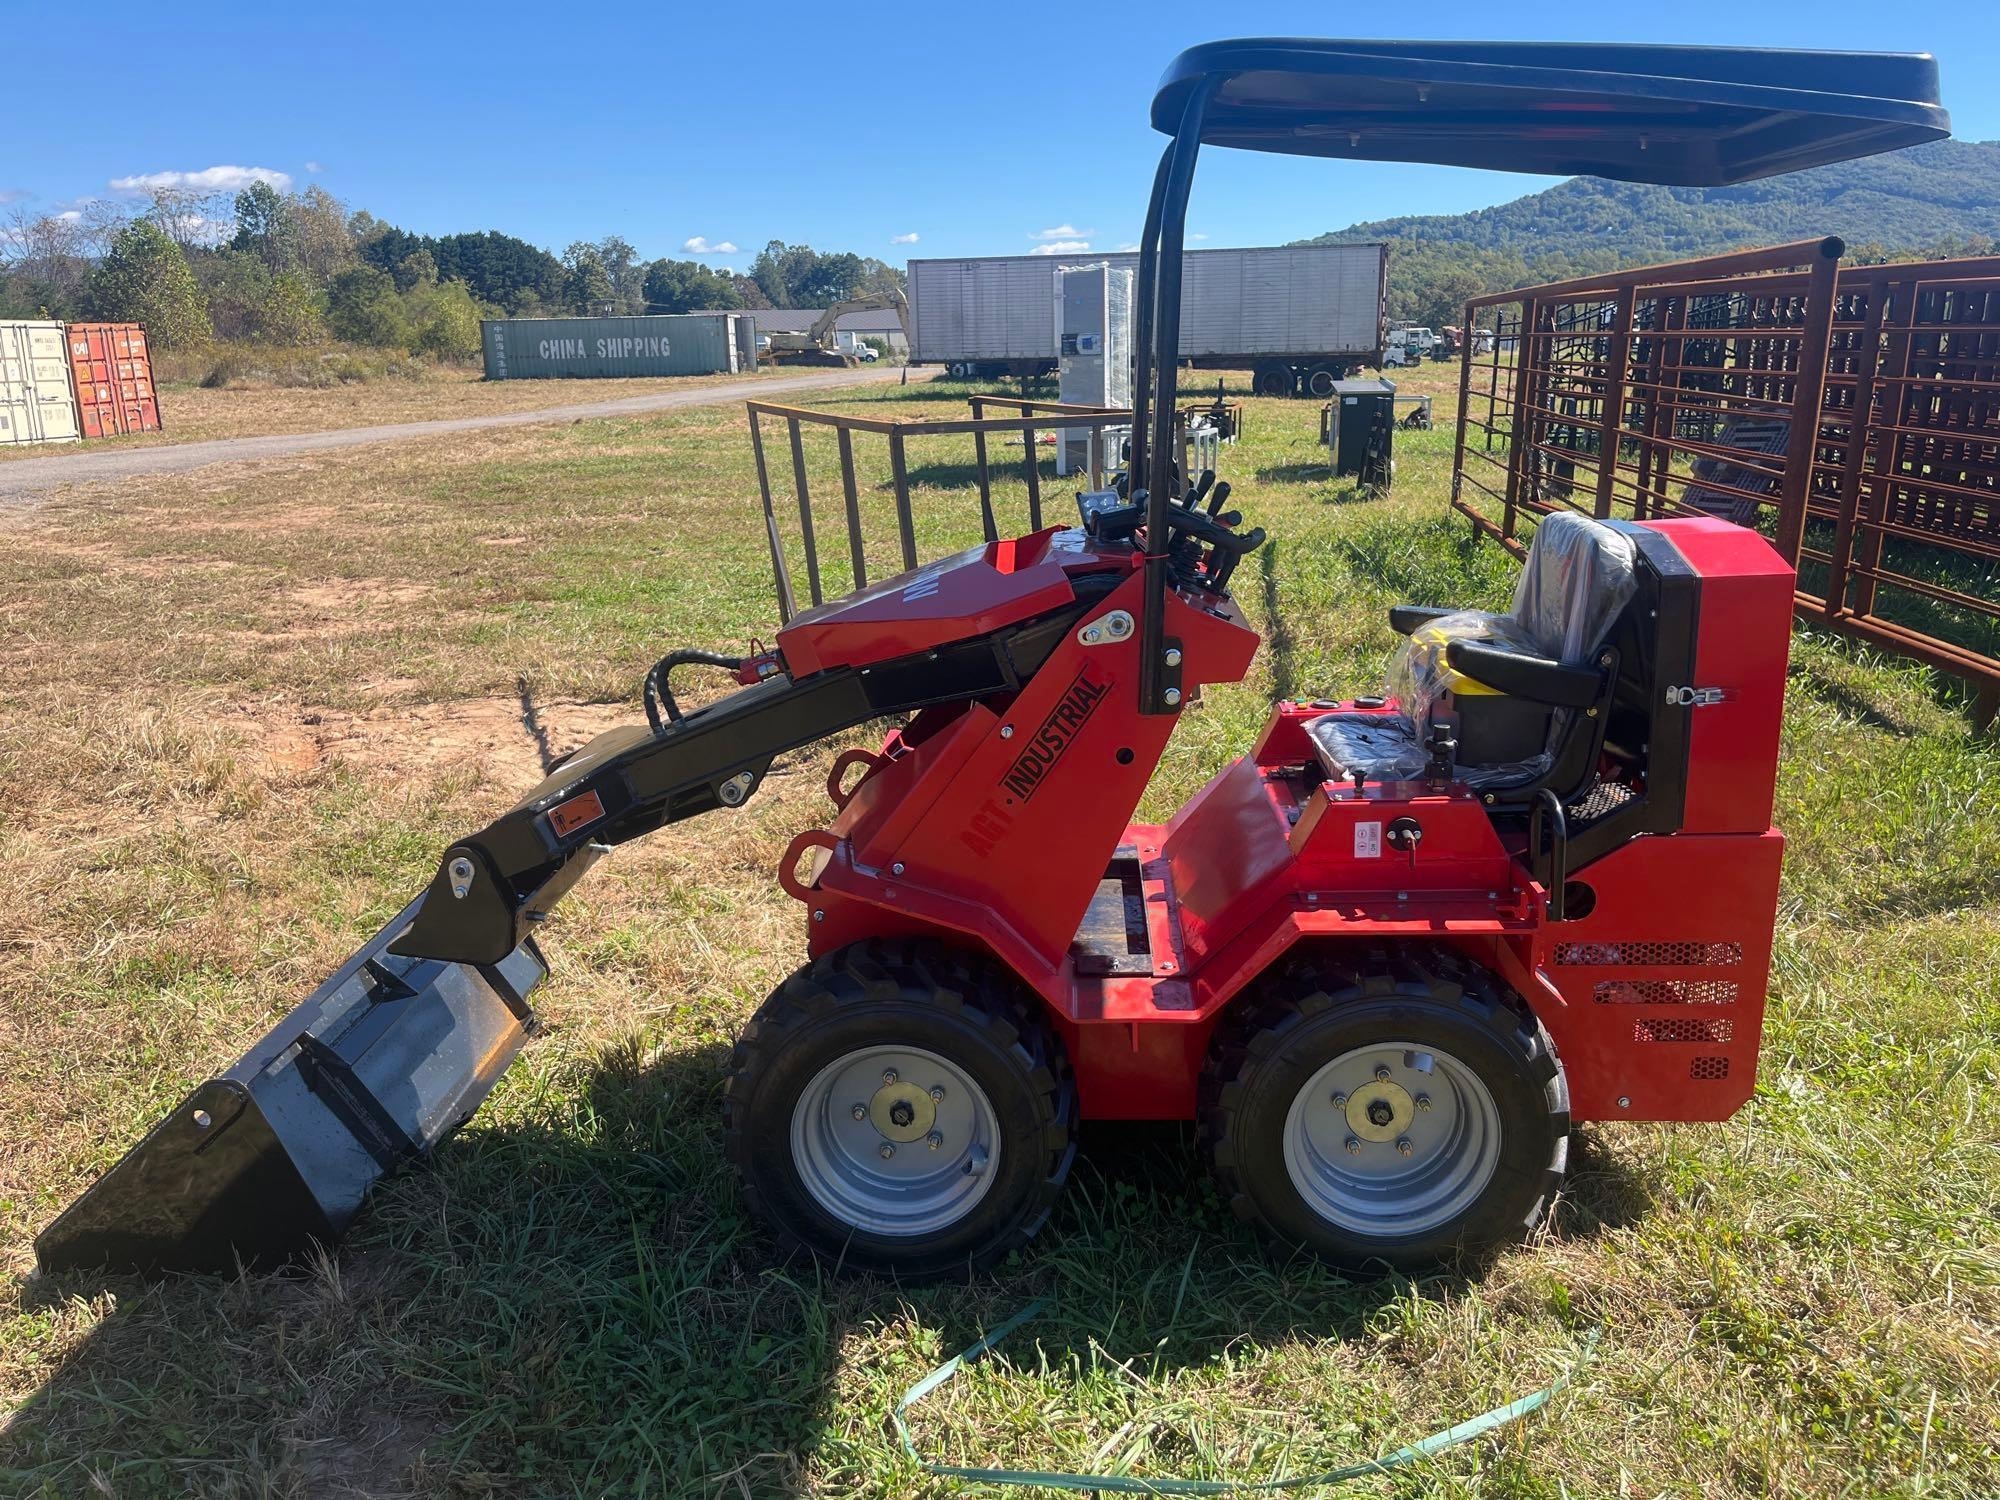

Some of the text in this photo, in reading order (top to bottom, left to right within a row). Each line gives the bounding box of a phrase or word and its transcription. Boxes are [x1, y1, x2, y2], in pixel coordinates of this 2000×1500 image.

[539, 337, 671, 360] CHINA SHIPPING
[960, 676, 1106, 858] AGT INDUSTRIAL
